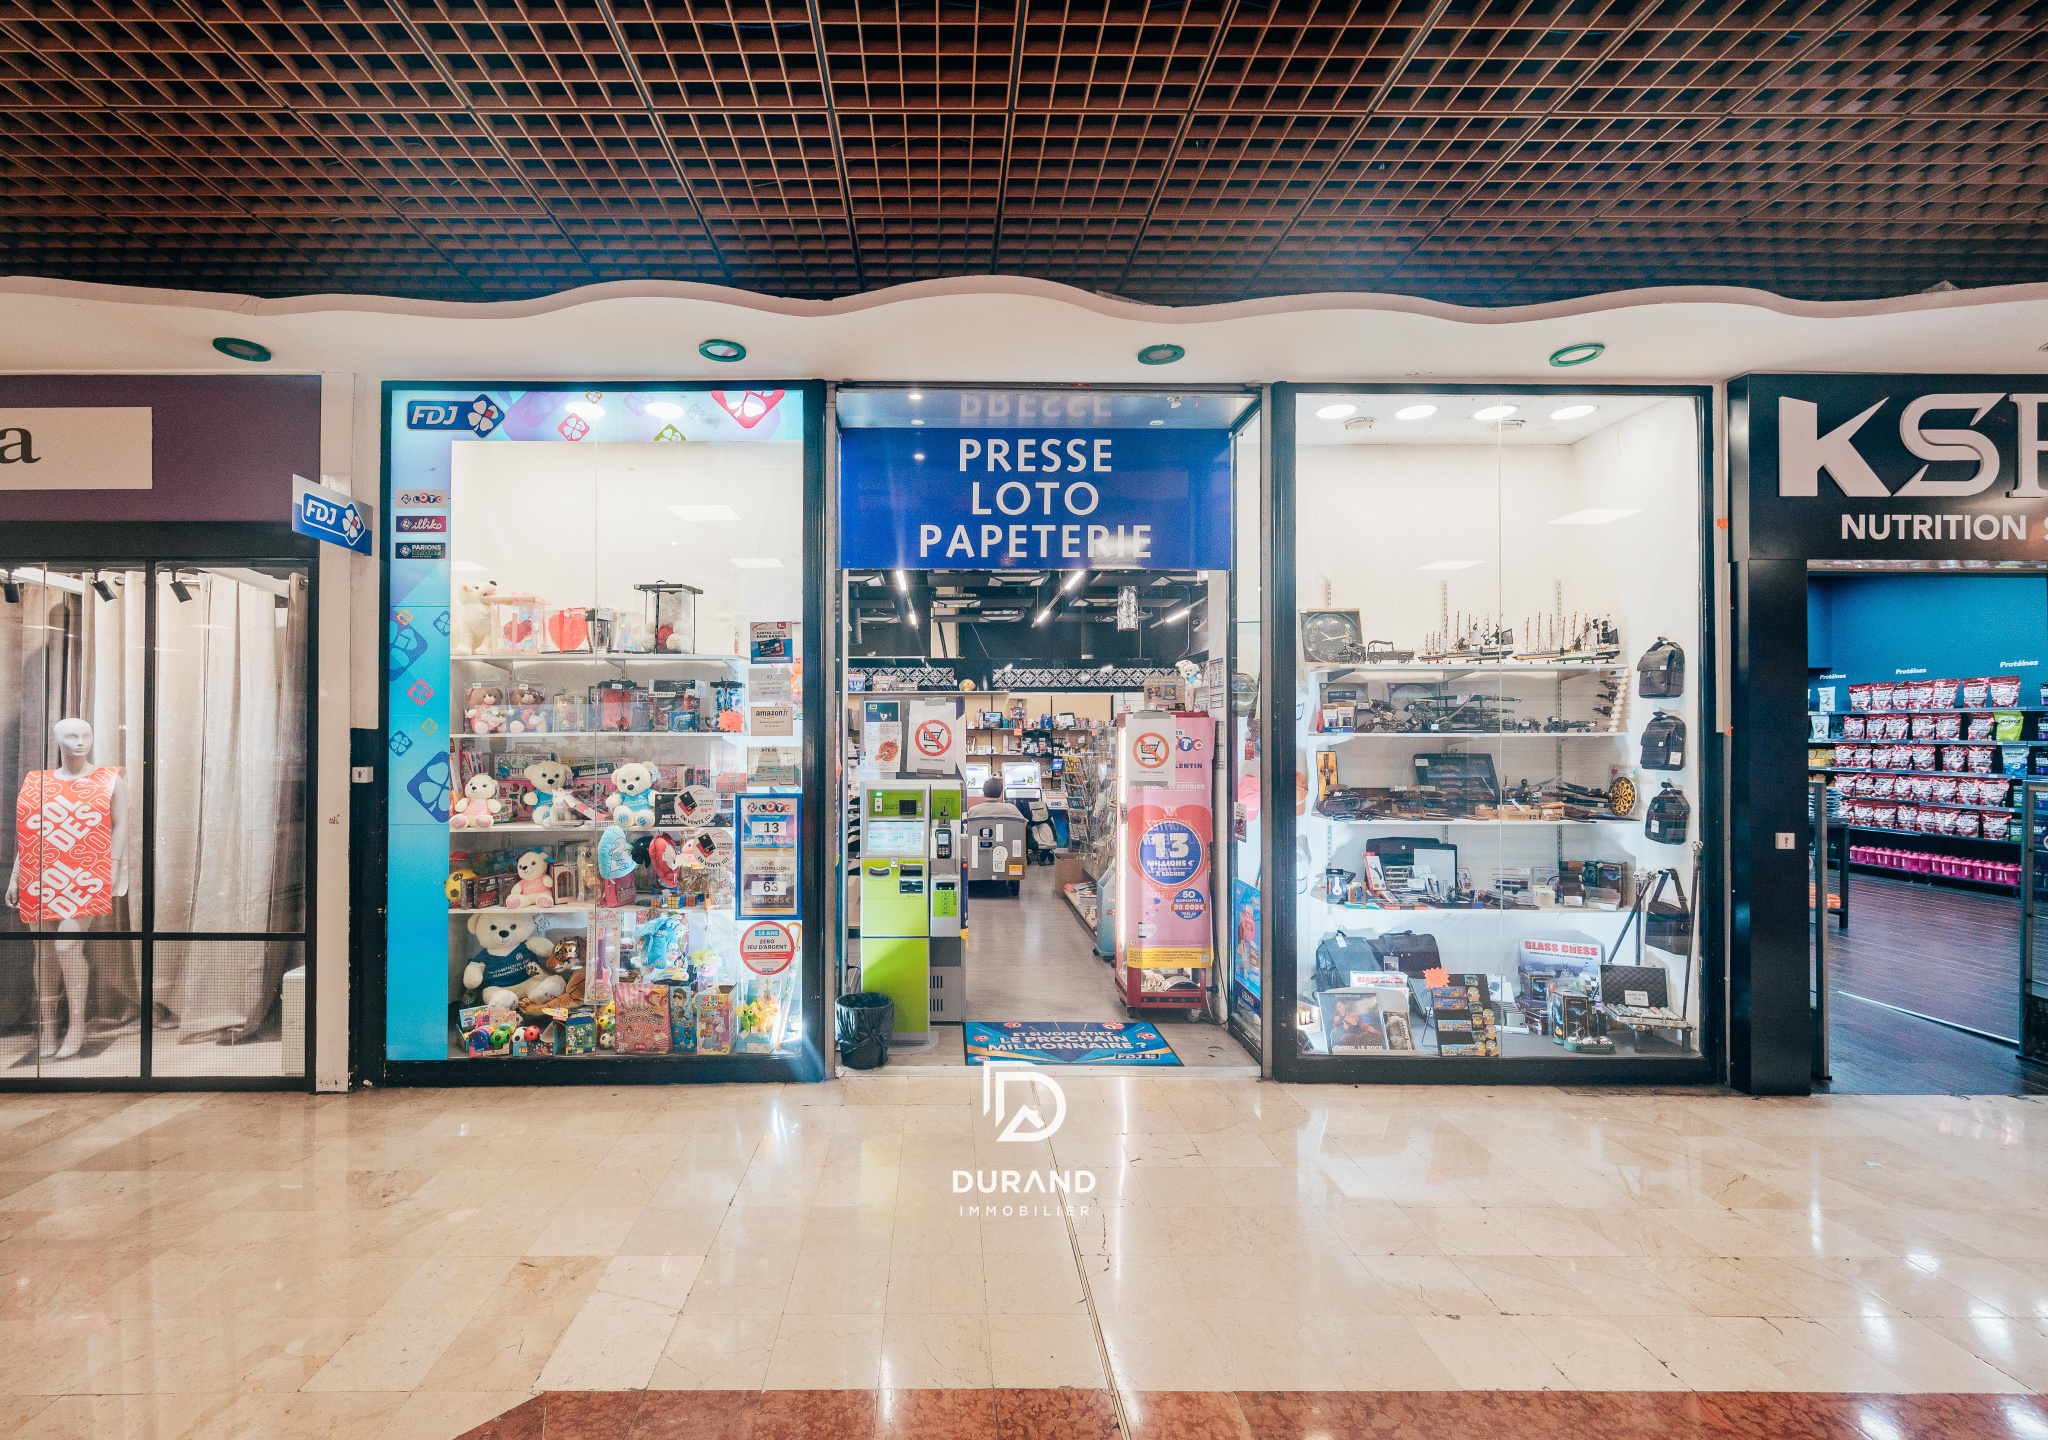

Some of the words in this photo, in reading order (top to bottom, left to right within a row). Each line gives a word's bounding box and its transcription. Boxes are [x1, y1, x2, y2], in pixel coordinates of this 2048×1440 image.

[411, 405, 457, 426] FDJ
[959, 439, 1112, 472] PRESSE
[412, 493, 442, 504] LOTO
[972, 482, 1099, 516] LOTO
[306, 498, 337, 526] FDJ
[412, 518, 442, 530] illiko
[1842, 514, 2026, 540] NUTRITION
[920, 524, 1152, 558] PAPETERIE
[759, 801, 791, 812] LOTO
[764, 822, 779, 833] 13
[1155, 833, 1189, 858] 13
[764, 882, 778, 892] 63
[1524, 941, 1558, 952] GLASS
[1562, 945, 1598, 956] CHESS
[987, 1042, 1134, 1051] MILLIONNAIRE
